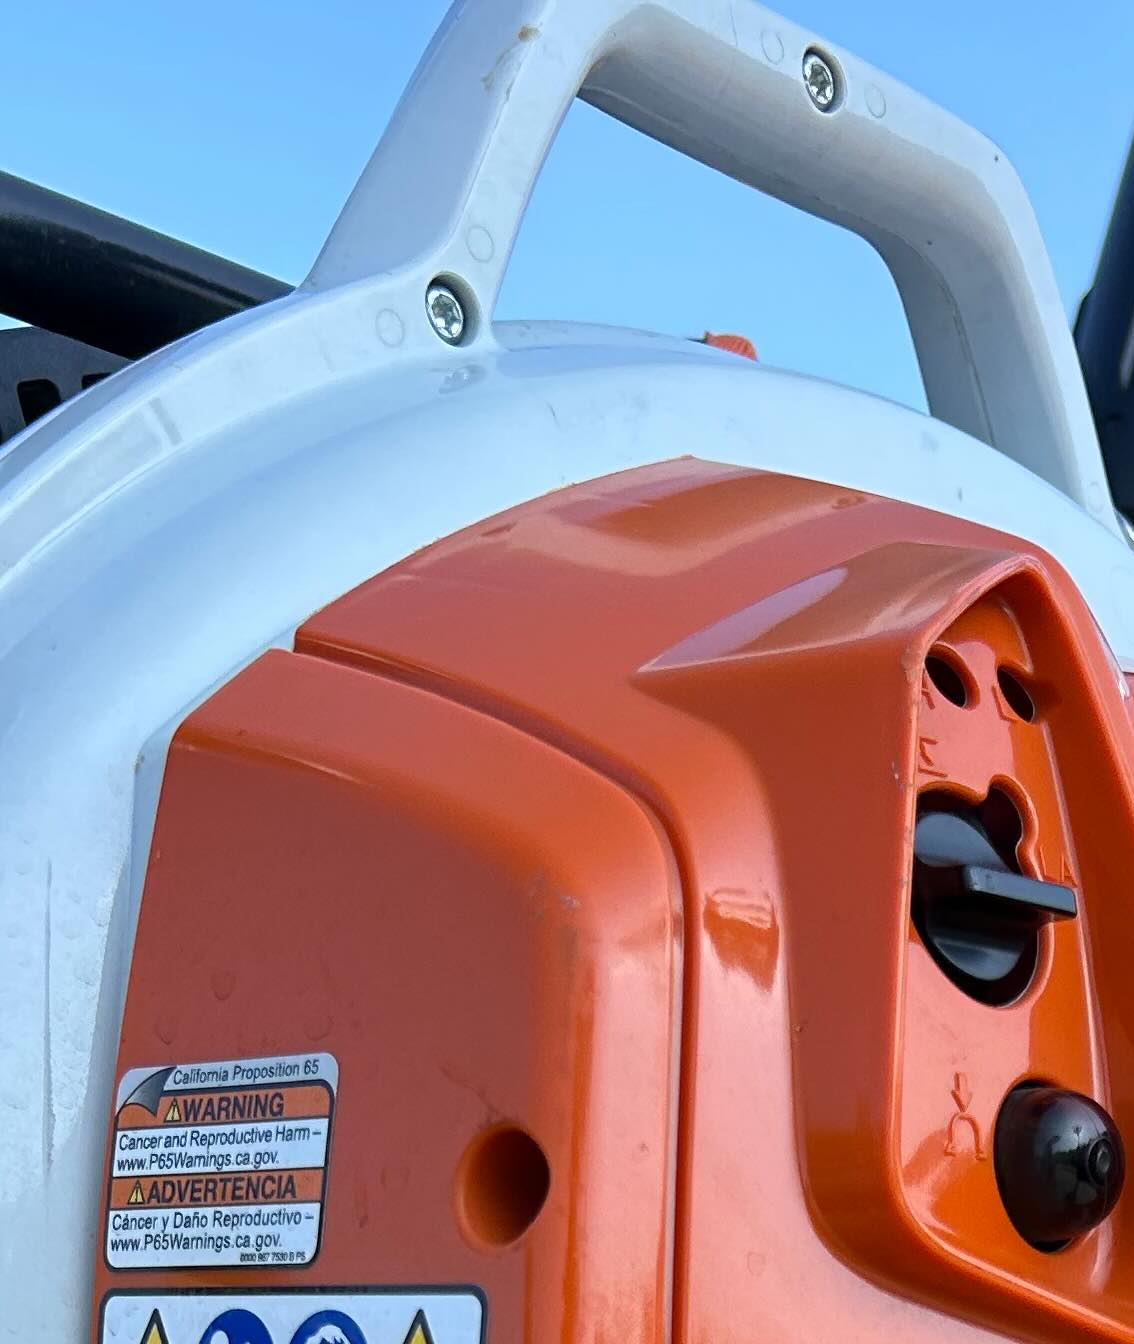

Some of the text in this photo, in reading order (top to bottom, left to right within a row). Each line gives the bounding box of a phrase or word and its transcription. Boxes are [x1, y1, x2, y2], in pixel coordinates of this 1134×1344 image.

[173, 1060, 319, 1085] California Proposition 65
[183, 1092, 284, 1123] WARNING
[119, 1134, 163, 1151] Cancer
[164, 1132, 186, 1148] and
[191, 1127, 272, 1151] Reproductive
[275, 1126, 310, 1142] Harm
[117, 1150, 279, 1172] www.P65Warnings.ca.gov.
[147, 1174, 297, 1204] ADVERTENCIA
[112, 1213, 157, 1231] Cáncer
[174, 1212, 208, 1229] Daño
[213, 1210, 302, 1229] Reproductivo
[111, 1233, 281, 1253] www.P65Warnings.ca.gov.
